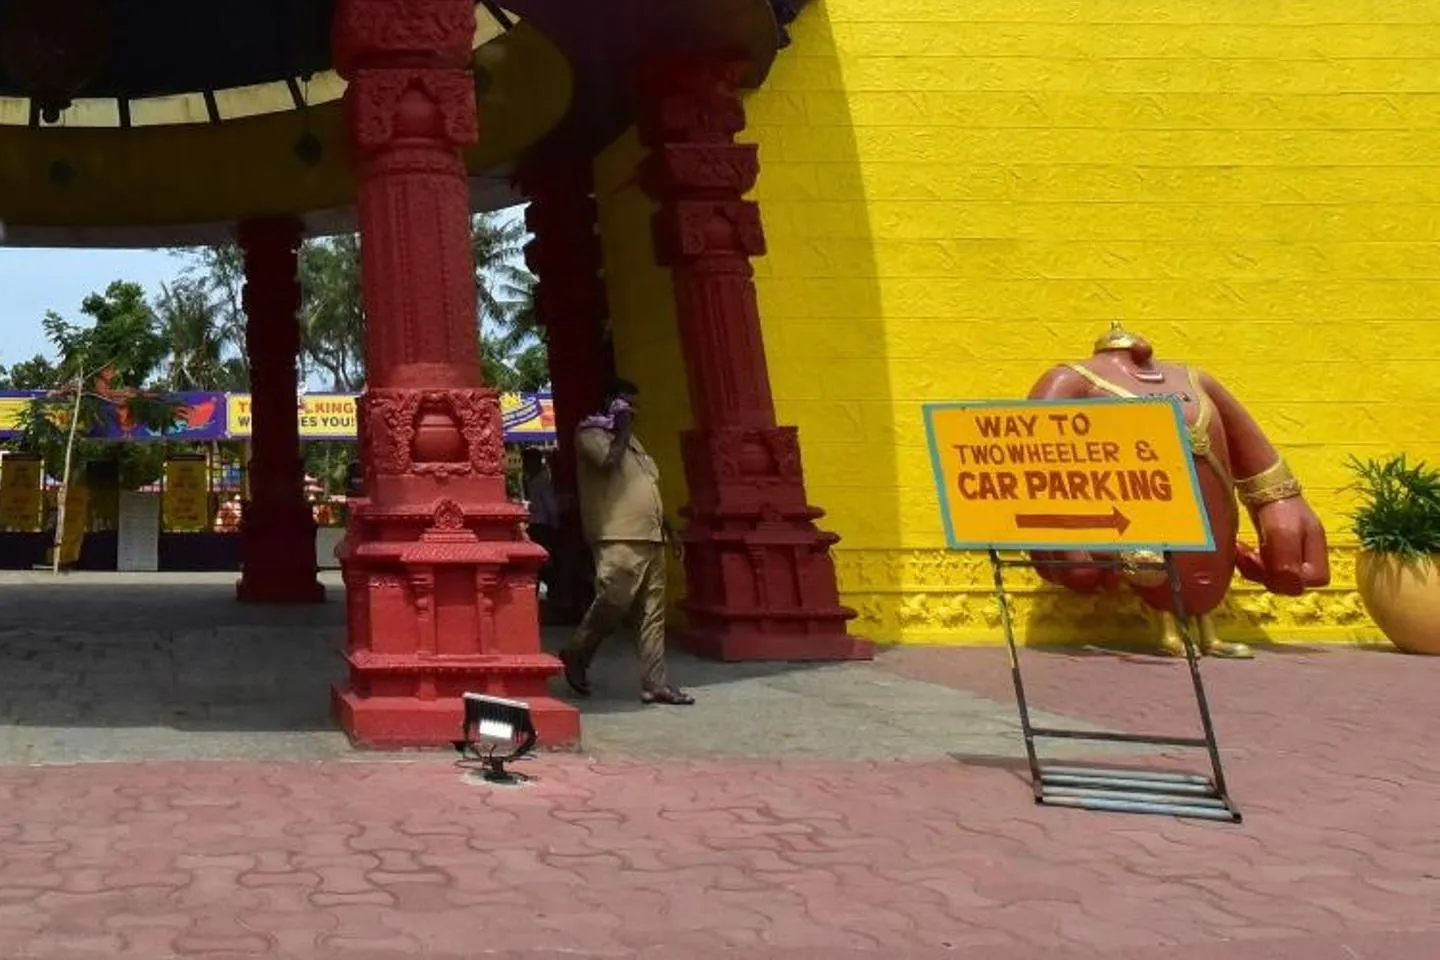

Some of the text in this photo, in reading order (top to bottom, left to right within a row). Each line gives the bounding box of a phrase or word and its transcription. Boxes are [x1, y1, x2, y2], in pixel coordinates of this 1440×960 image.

[322, 416, 354, 427] YOU!
[975, 413, 1092, 438] WAY TO
[1135, 440, 1159, 462] &
[957, 469, 1173, 502] CAR PARKING
